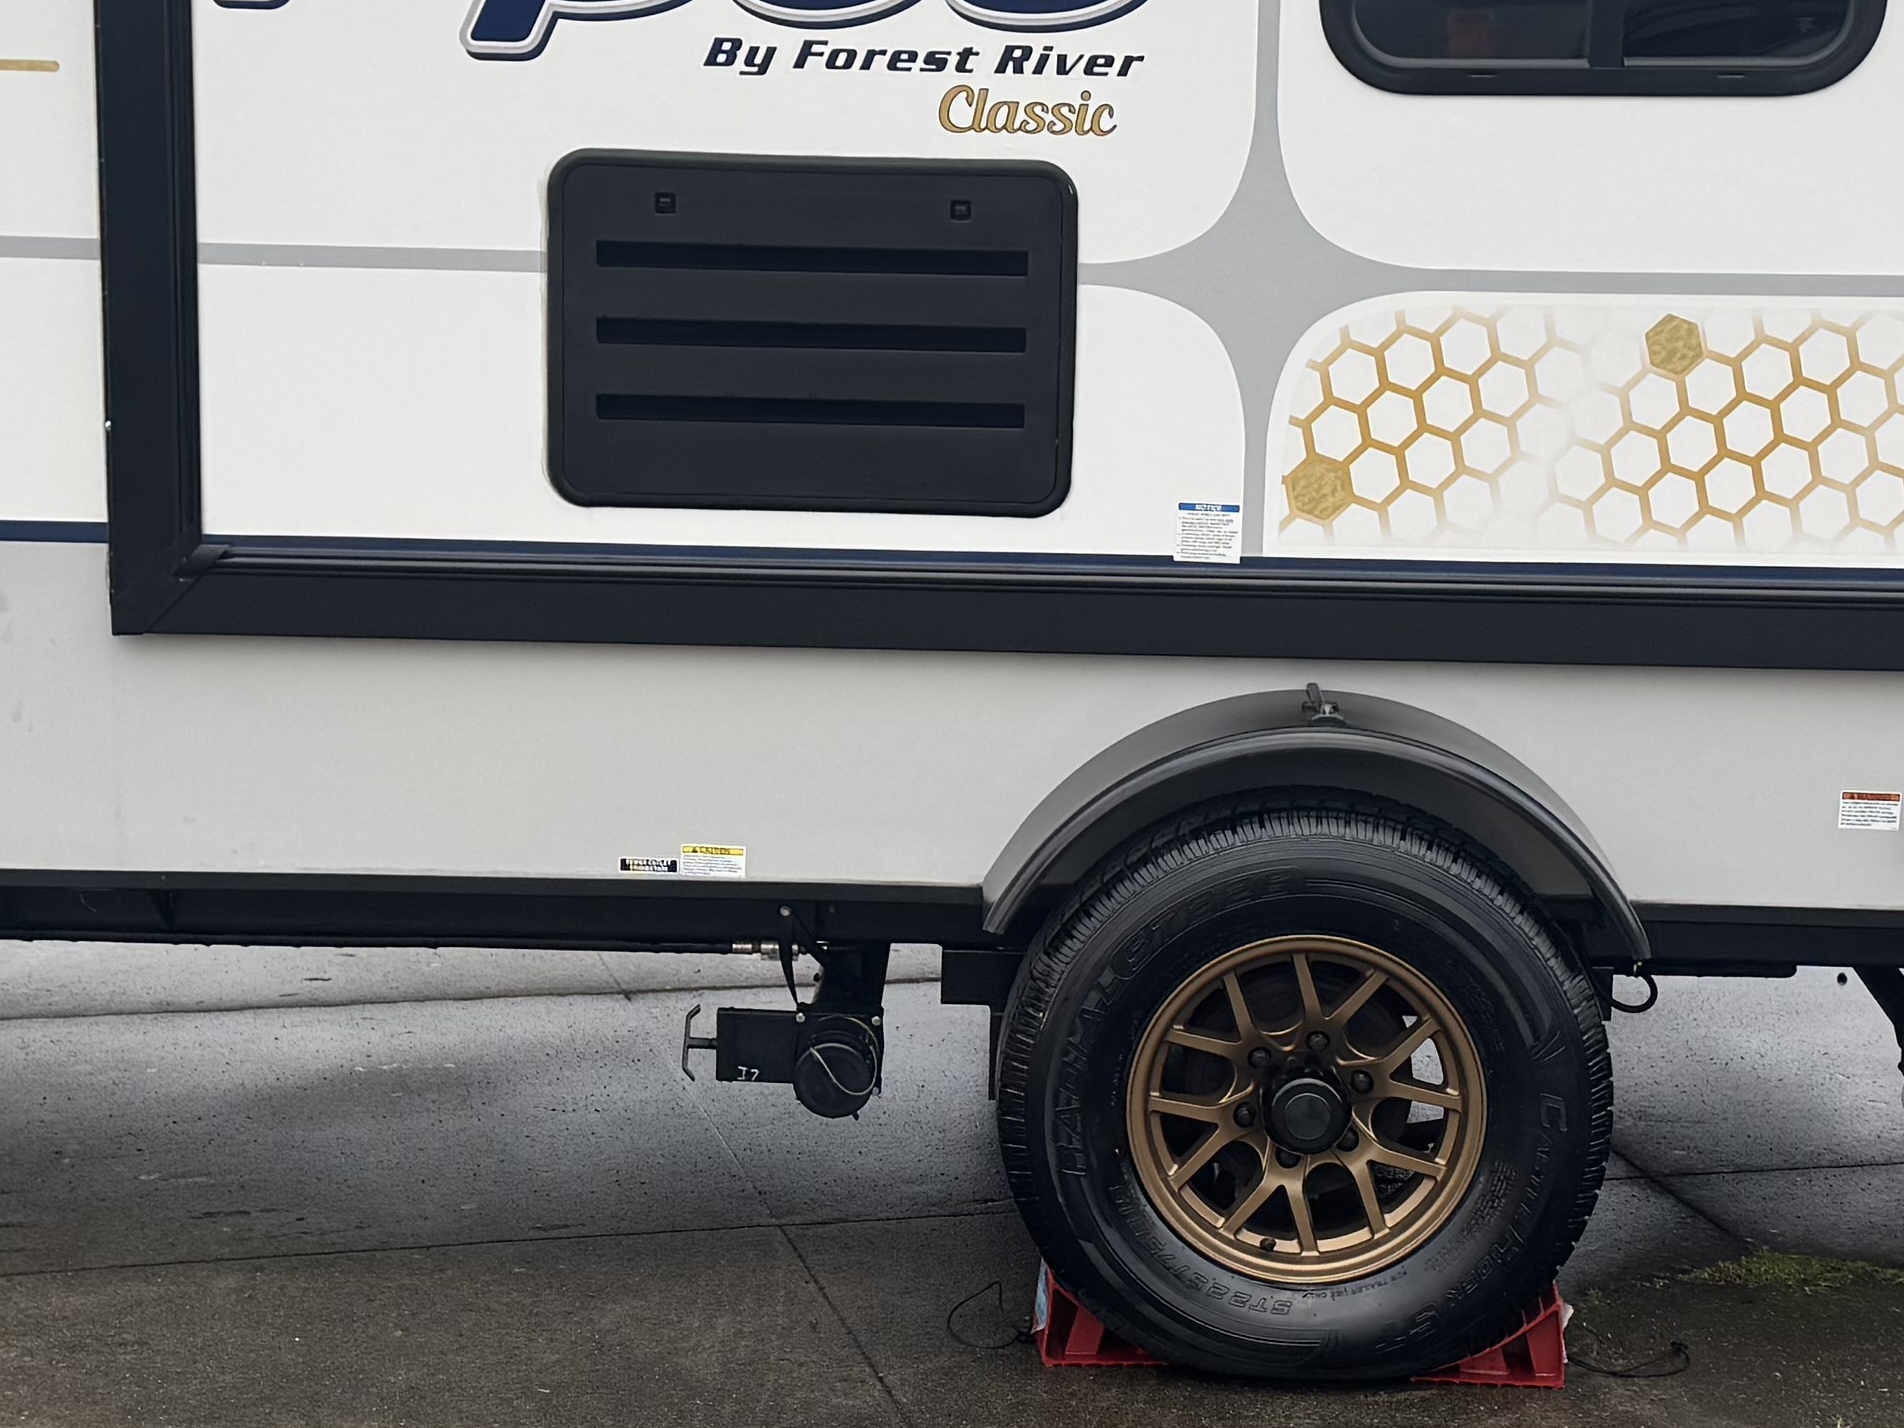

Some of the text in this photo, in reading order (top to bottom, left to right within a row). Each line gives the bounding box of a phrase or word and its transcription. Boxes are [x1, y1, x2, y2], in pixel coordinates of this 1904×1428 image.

[703, 37, 1145, 77] By Forest River
[938, 85, 1117, 136] Classic
